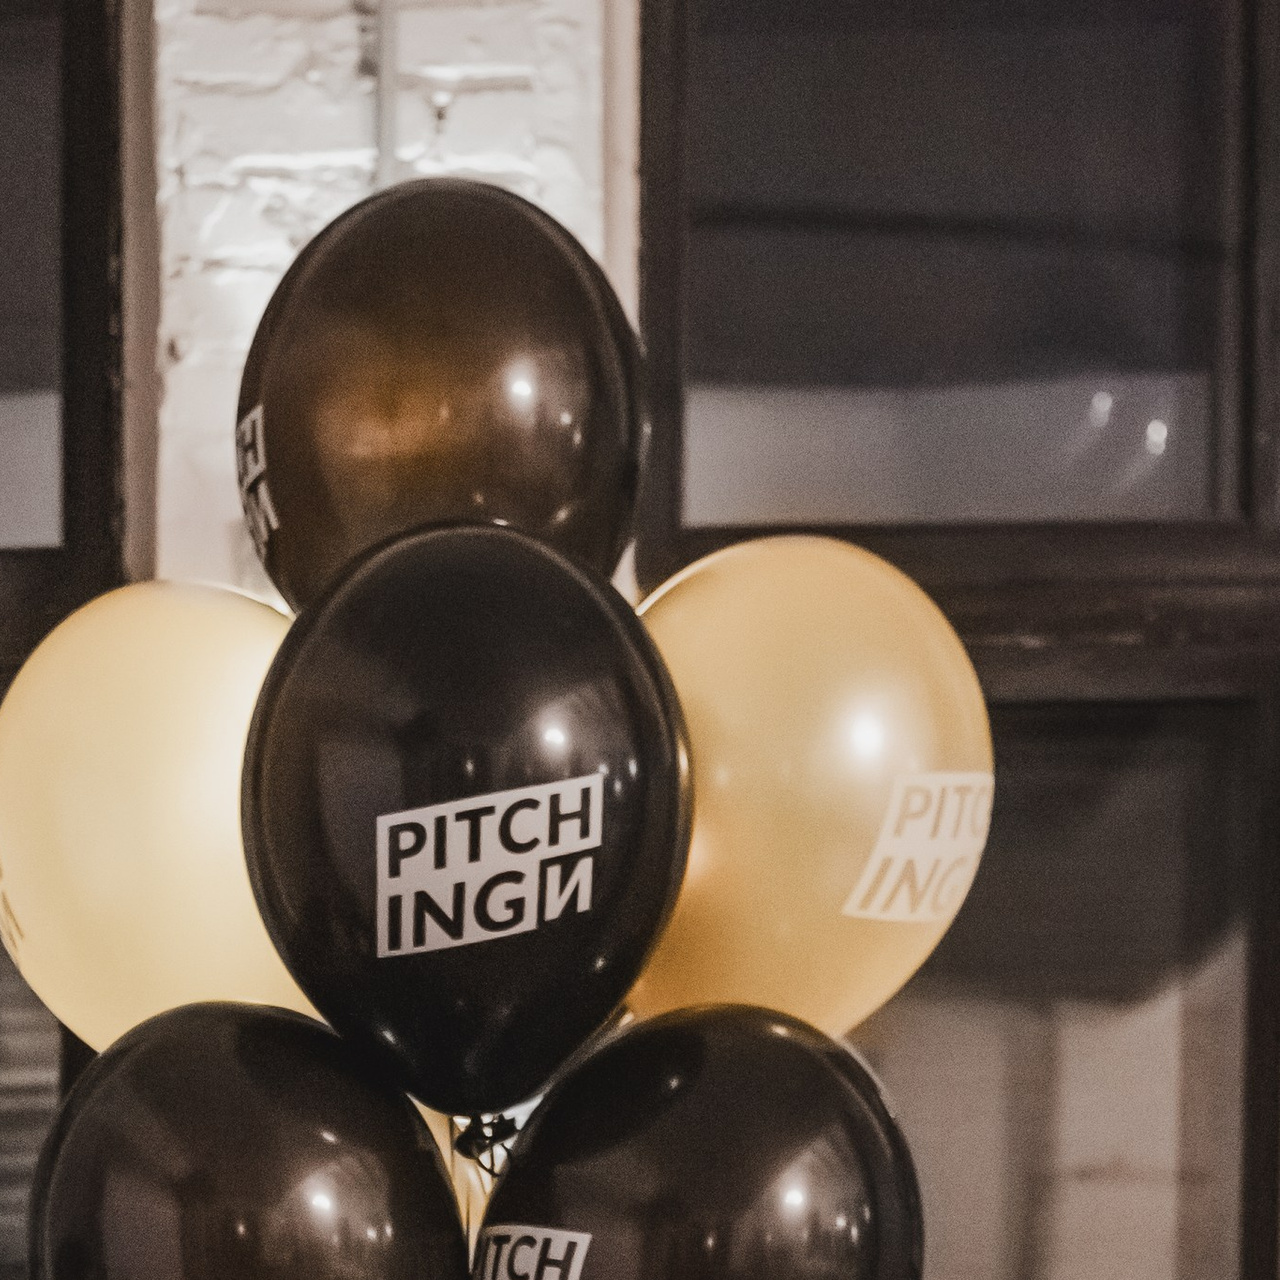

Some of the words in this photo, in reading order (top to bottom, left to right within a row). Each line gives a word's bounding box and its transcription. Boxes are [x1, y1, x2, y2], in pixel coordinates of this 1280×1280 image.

[388, 786, 592, 879] PITCH
[893, 785, 989, 839] PITC
[857, 856, 969, 915] ING
